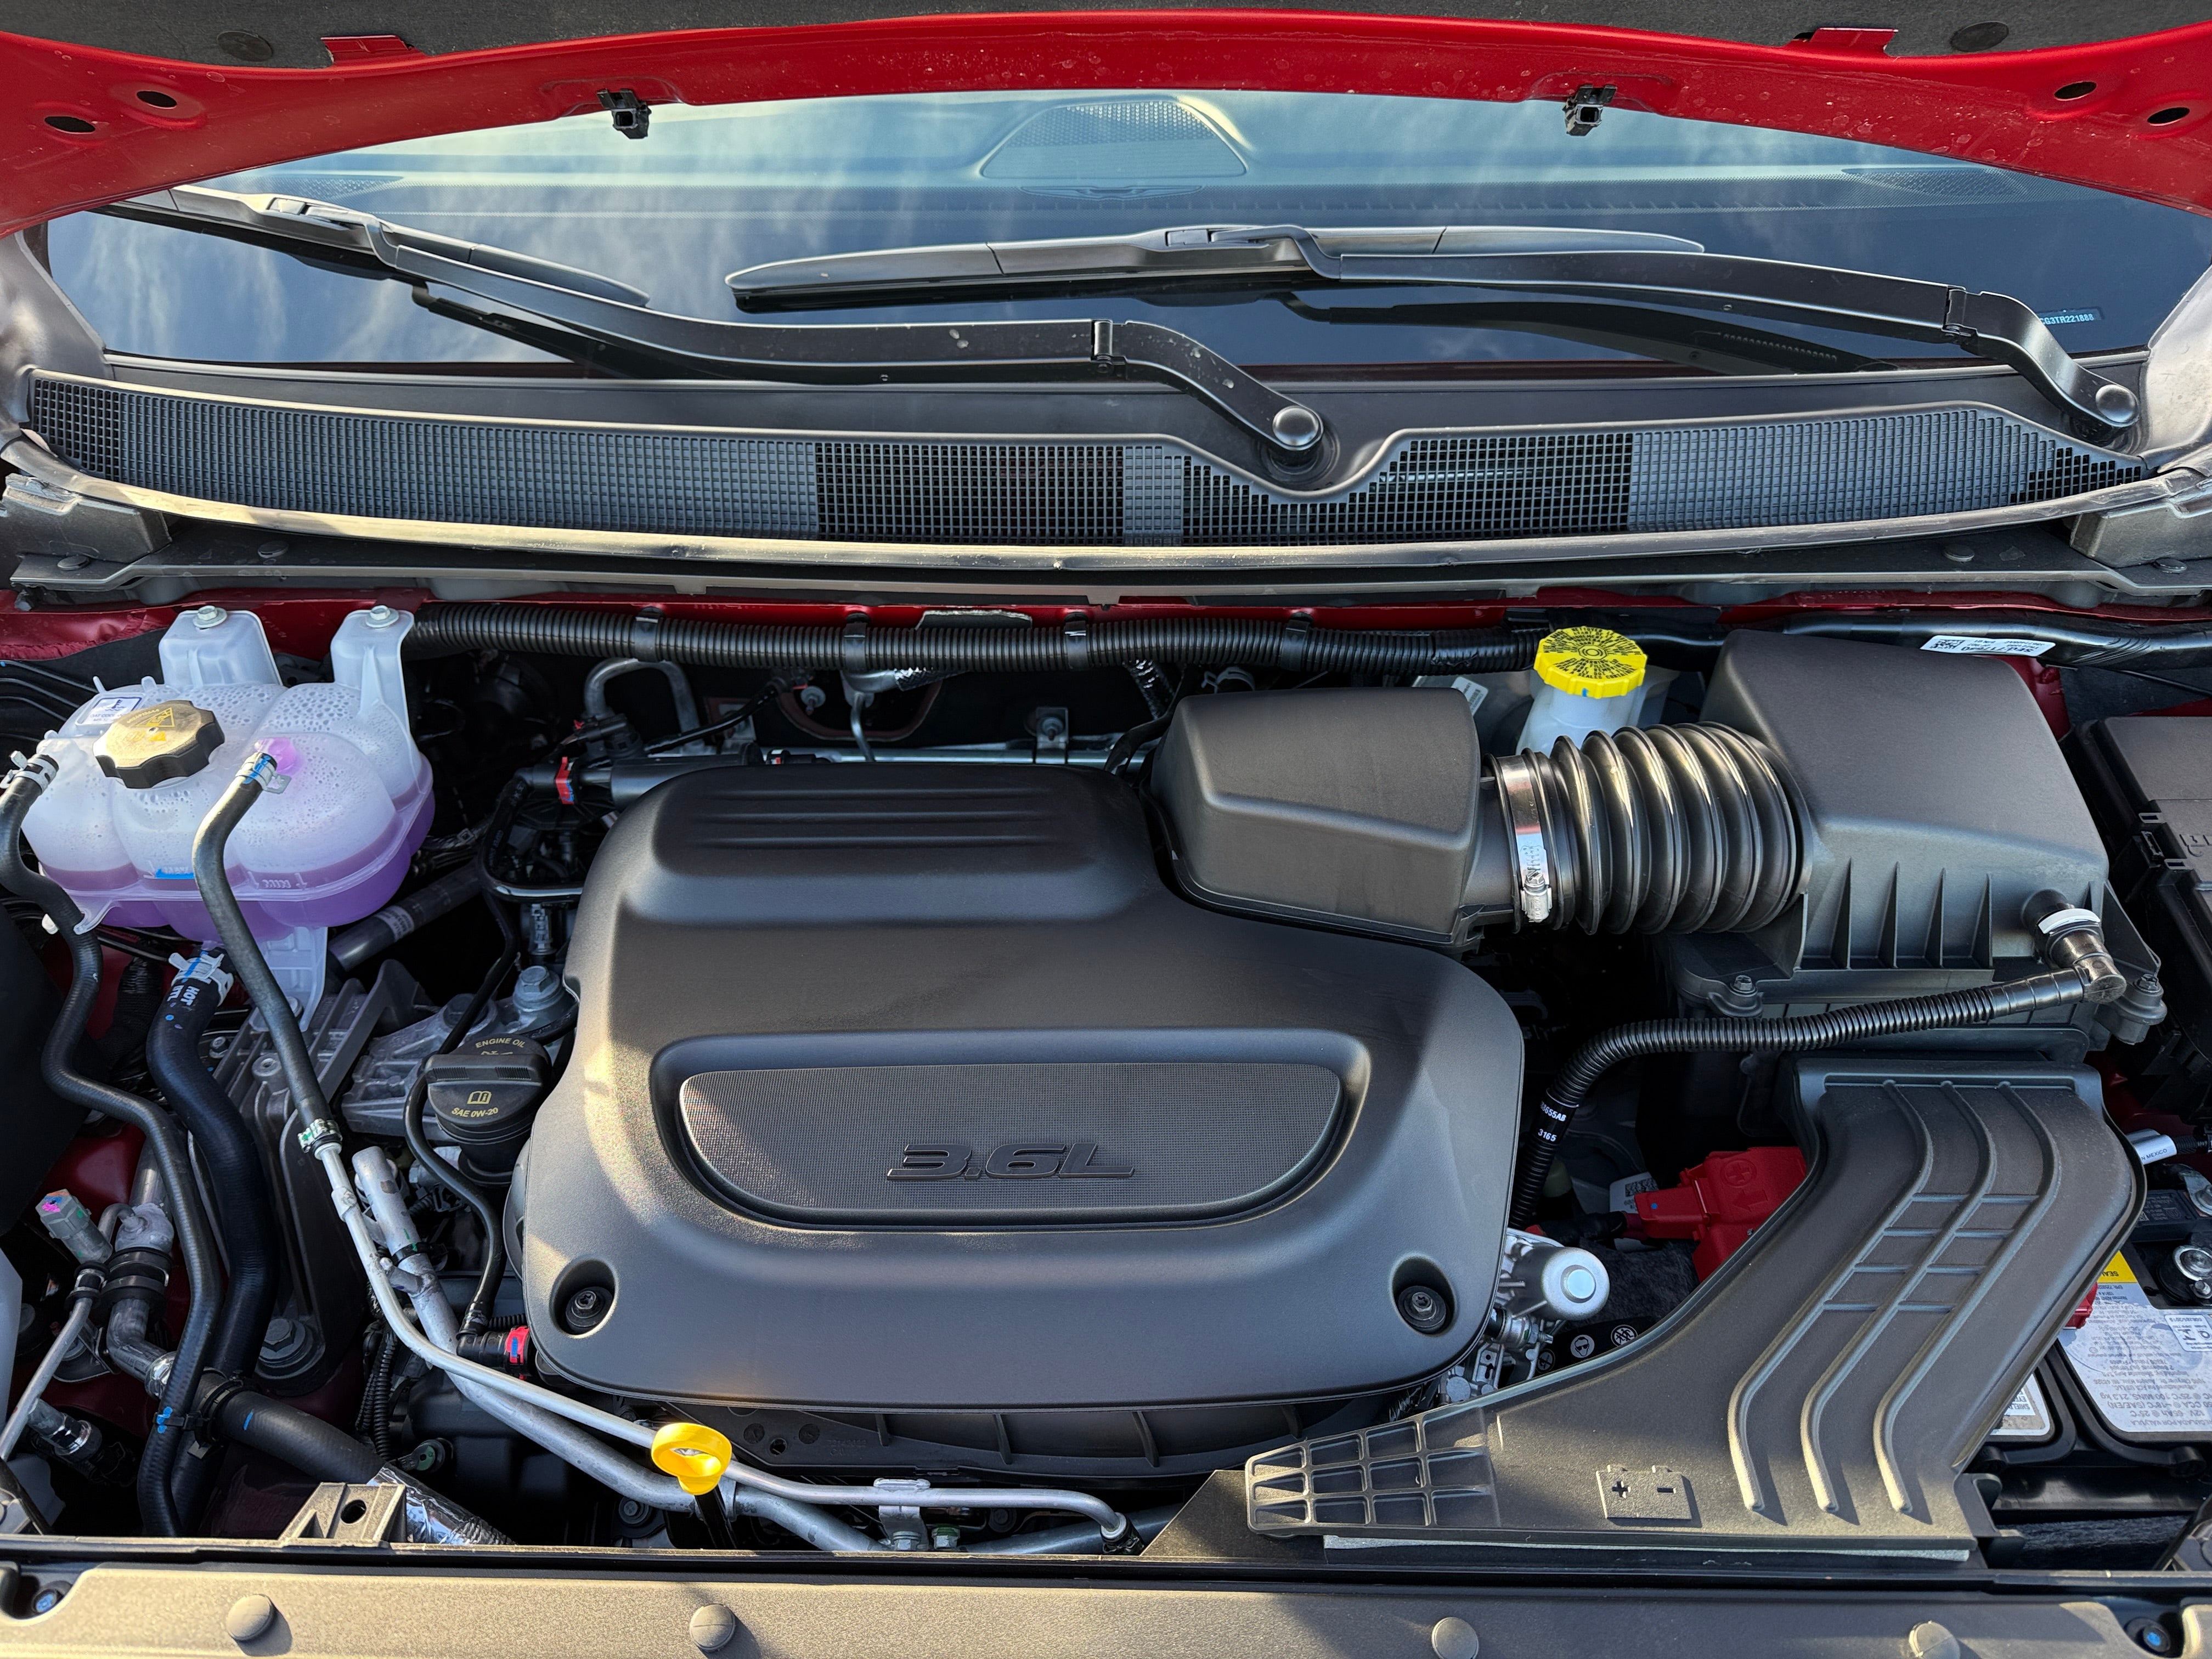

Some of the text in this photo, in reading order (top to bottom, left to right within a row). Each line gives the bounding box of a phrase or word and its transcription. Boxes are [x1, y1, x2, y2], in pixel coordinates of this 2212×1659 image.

[180, 986, 200, 1006] HOT
[475, 1037, 526, 1048] ENGINE OIL
[452, 1107, 499, 1118] SAE 0W-20
[1538, 1128, 1557, 1142] 3165
[2146, 1148, 2168, 1159] MEXICO
[887, 1142, 1136, 1181] 3.6L
[2100, 1392, 2112, 1401] kg
